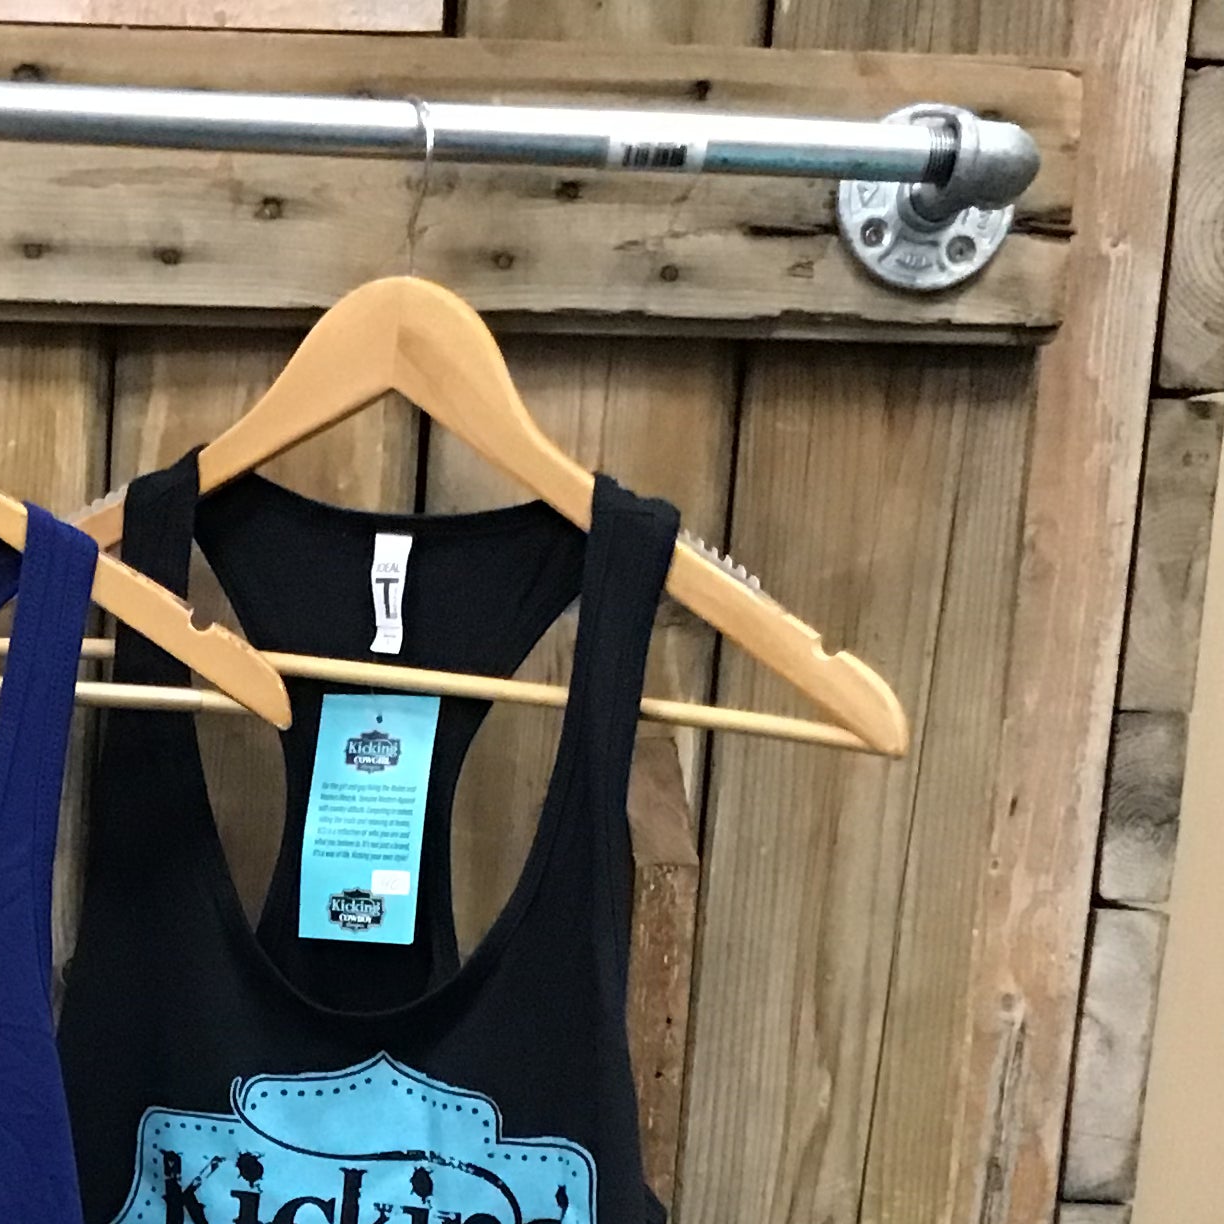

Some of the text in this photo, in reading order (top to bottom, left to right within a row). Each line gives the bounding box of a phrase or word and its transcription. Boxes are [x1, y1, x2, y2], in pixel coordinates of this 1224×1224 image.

[376, 563, 400, 573] IDEAL
[348, 740, 398, 757] Kicking
[331, 898, 381, 916] Kicking
